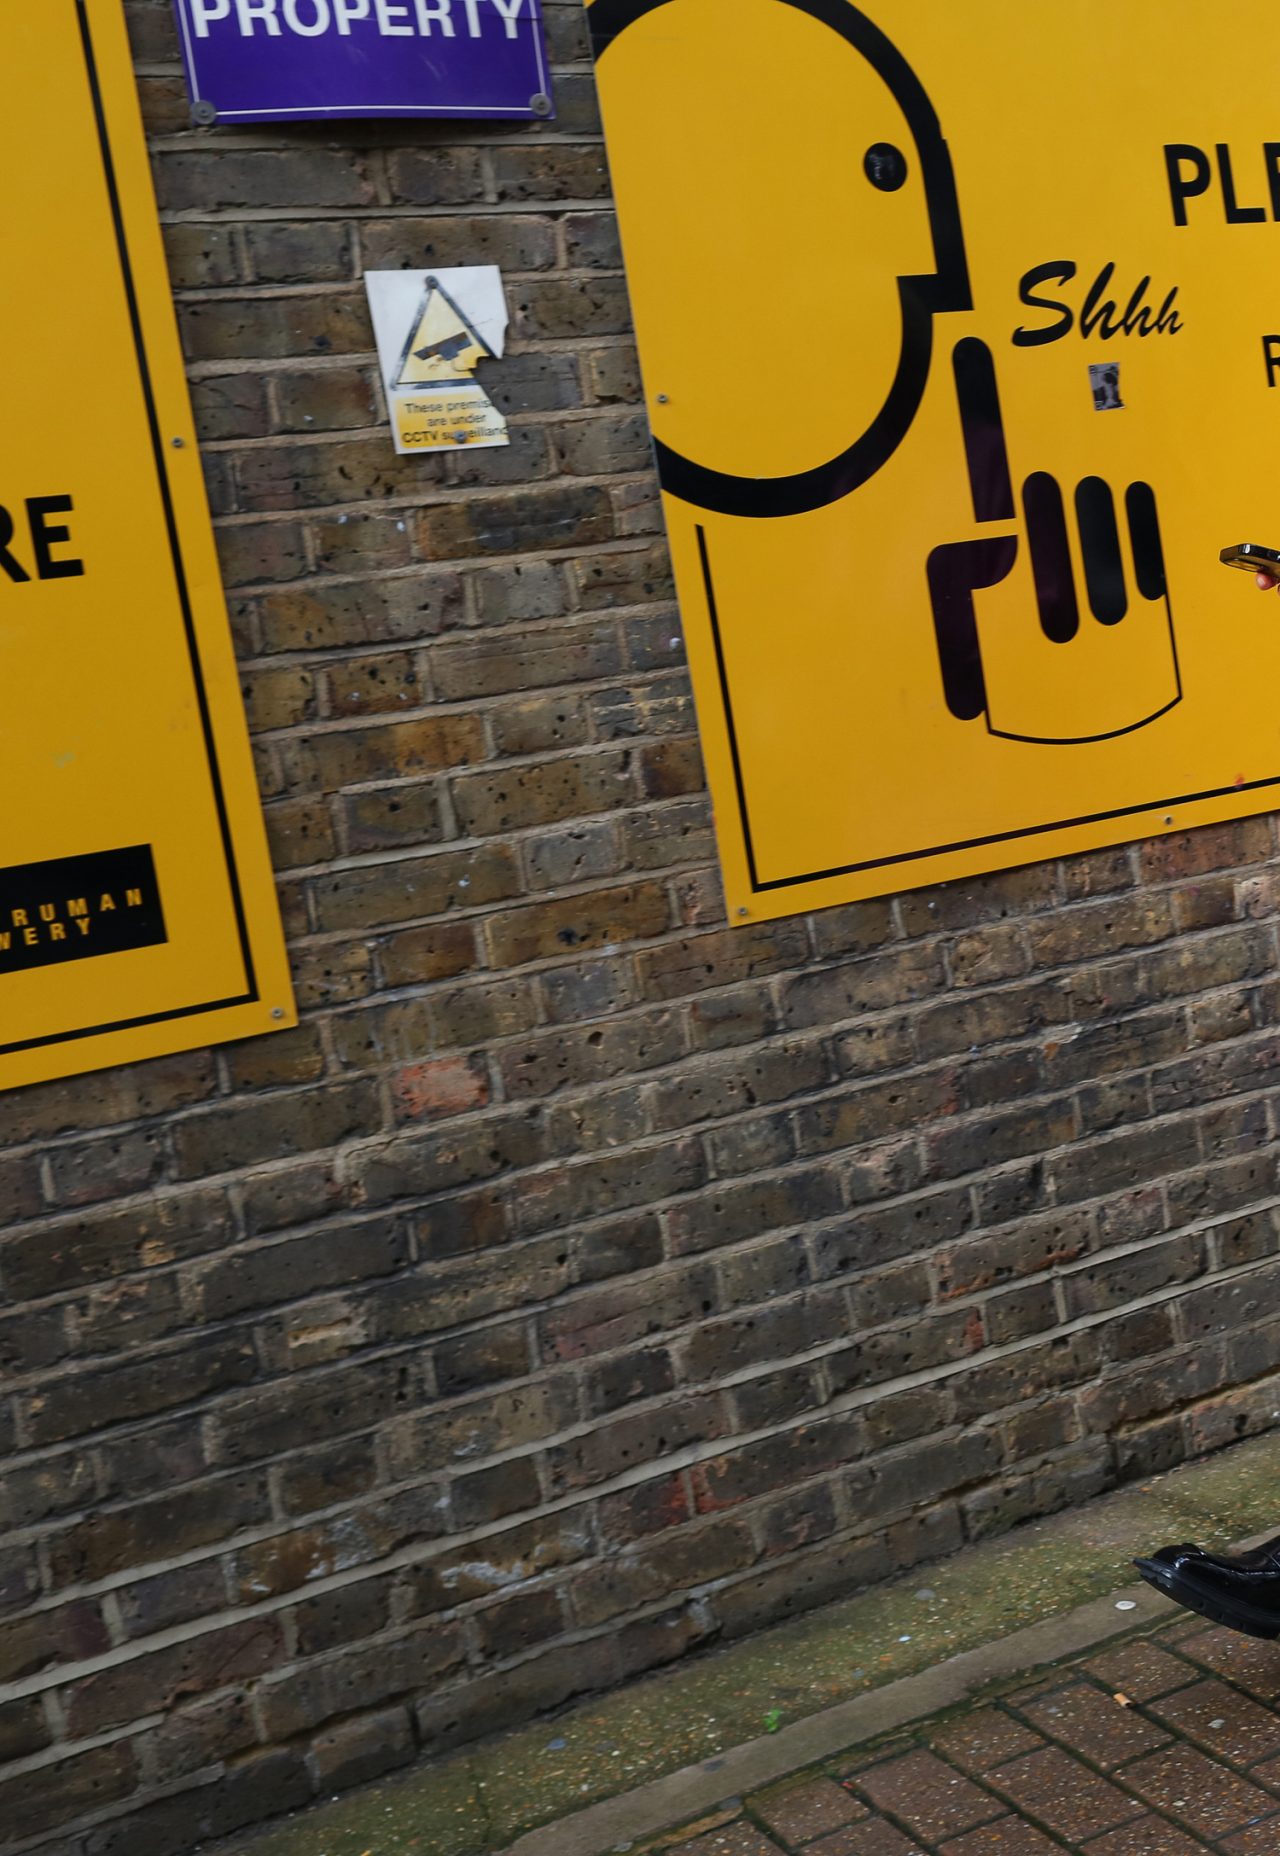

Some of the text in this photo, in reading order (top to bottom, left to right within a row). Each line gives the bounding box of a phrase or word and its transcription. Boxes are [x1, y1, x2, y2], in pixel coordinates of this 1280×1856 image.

[193, 0, 524, 39] PROPERTY
[1011, 260, 1184, 347] Shhh
[404, 400, 492, 414] These premis
[427, 413, 486, 427] are under
[402, 431, 439, 443] CCTV
[11, 888, 142, 927] RUMAN
